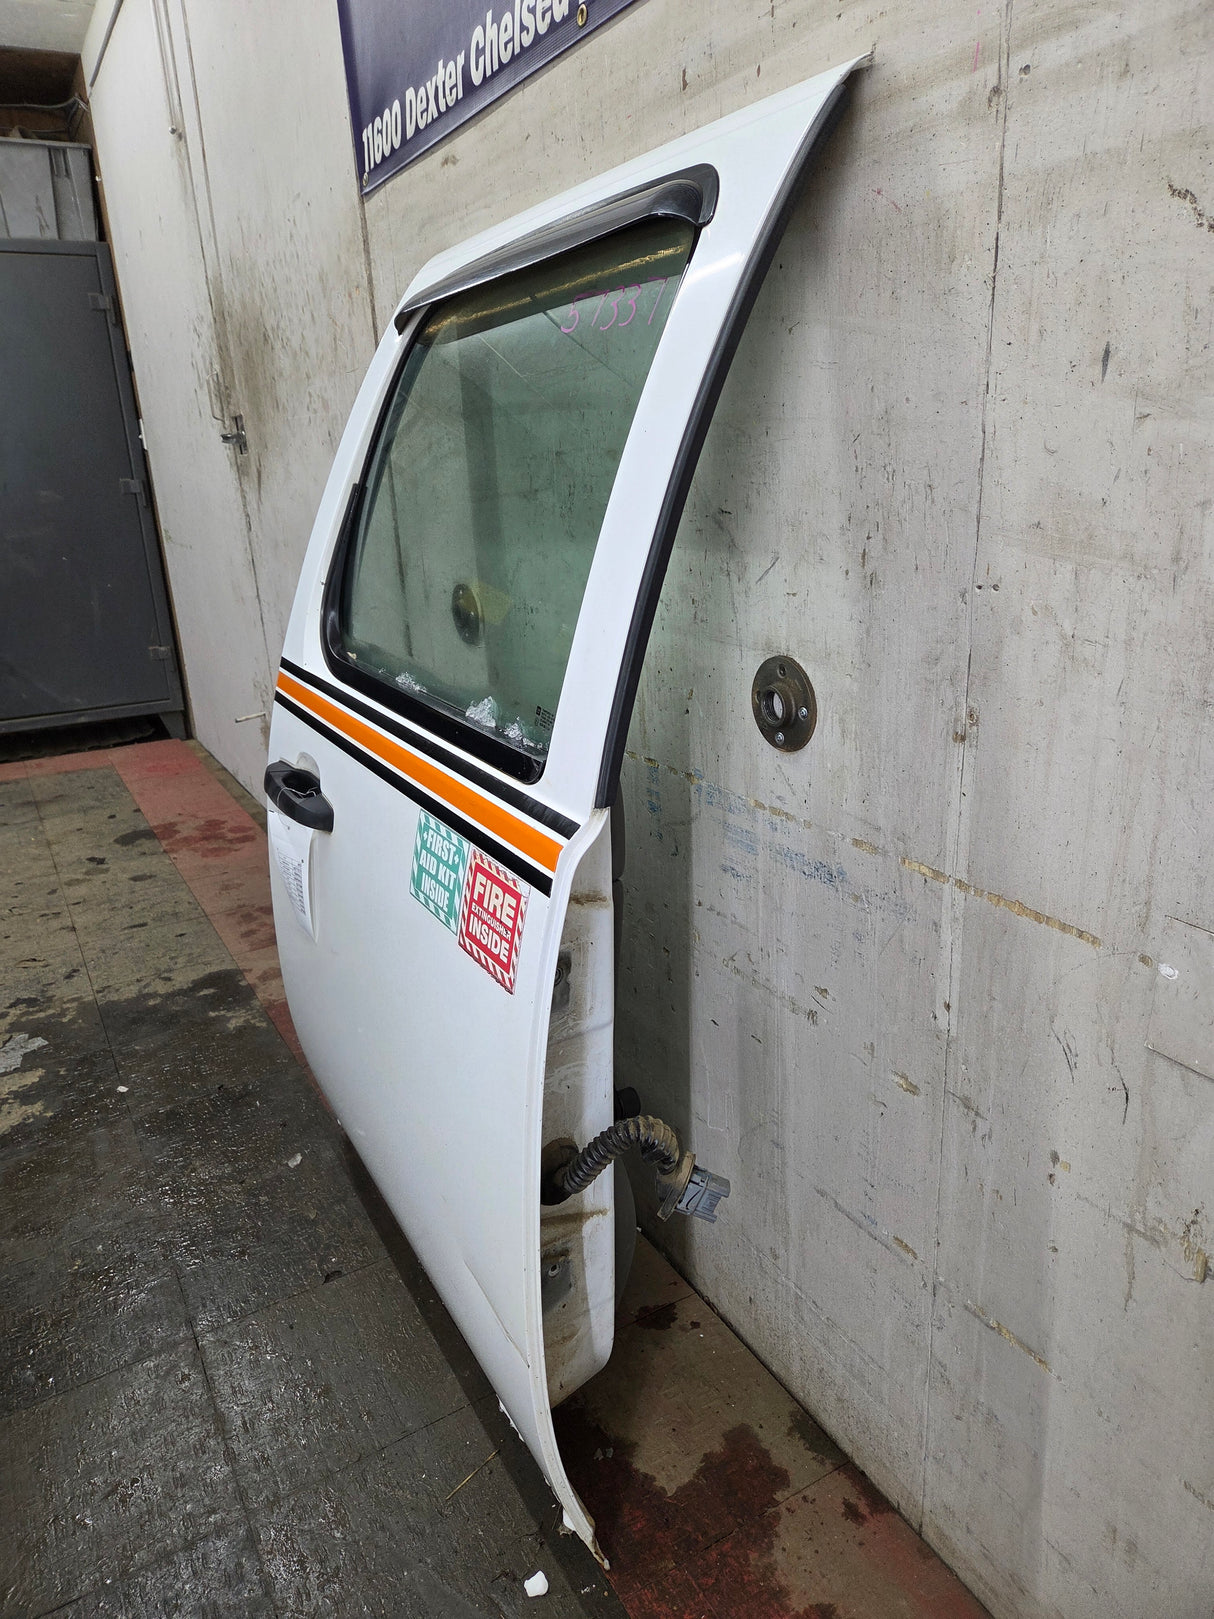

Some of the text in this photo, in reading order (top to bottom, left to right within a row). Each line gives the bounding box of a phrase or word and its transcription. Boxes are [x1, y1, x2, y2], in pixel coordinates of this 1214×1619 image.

[362, 99, 401, 172] 11600
[406, 50, 464, 140] Dexter
[426, 829, 457, 865] FIRST
[419, 848, 457, 890] AID KIT
[421, 872, 450, 912] INSIDE
[473, 872, 517, 929] FIRE
[469, 913, 510, 963] INSIDE
[471, 902, 512, 941] EXTINGUISHER
